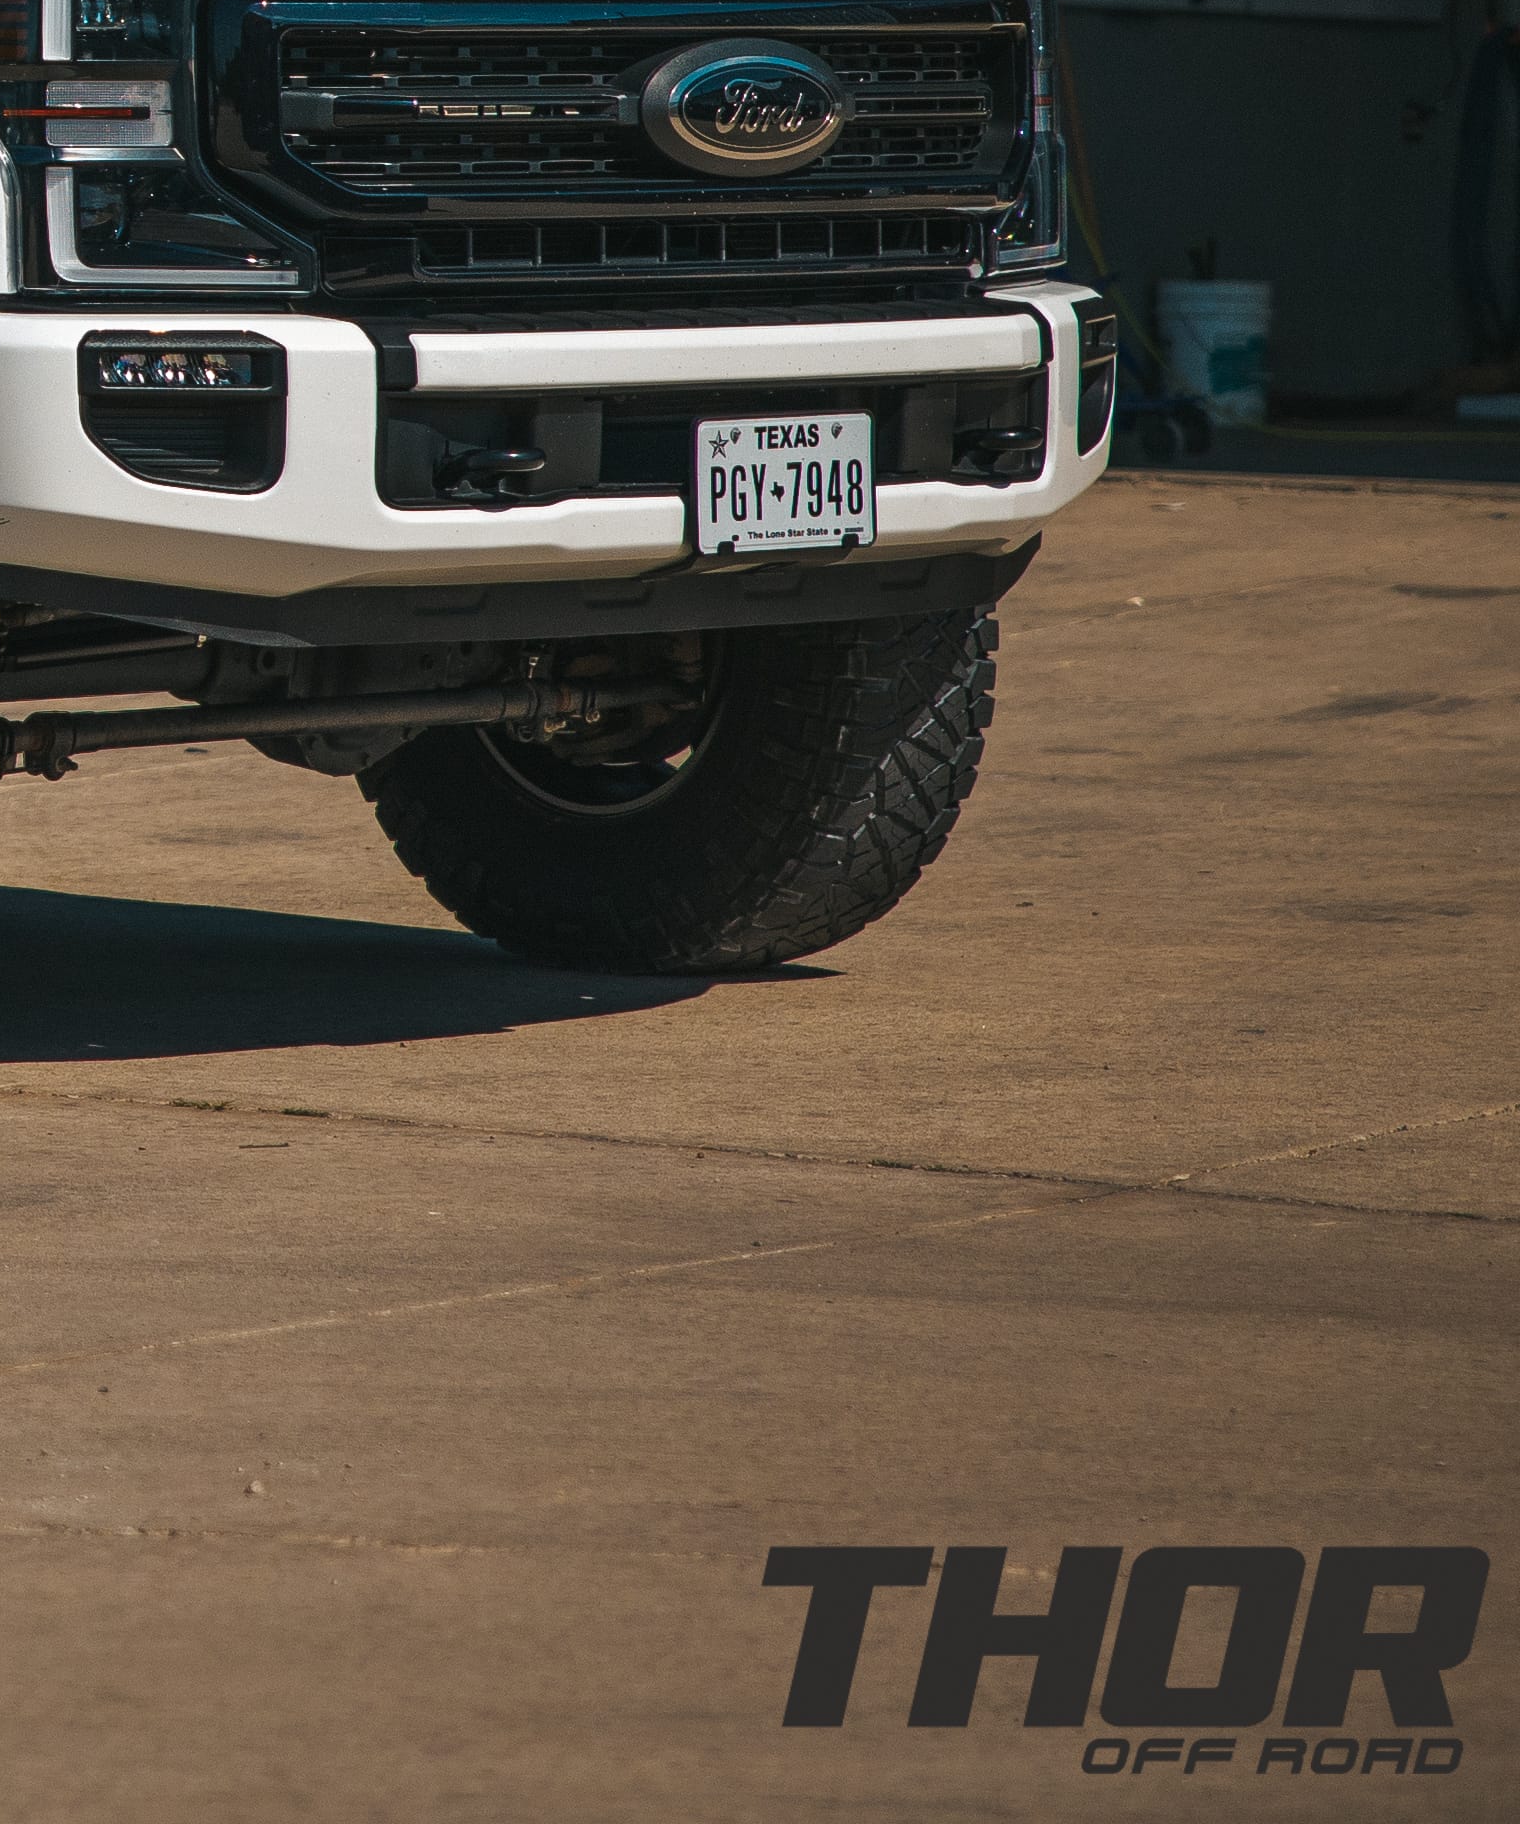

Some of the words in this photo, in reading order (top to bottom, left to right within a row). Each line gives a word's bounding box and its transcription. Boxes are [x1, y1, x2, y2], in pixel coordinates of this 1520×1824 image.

[714, 77, 805, 135] Ford
[753, 423, 820, 451] TEXAS
[710, 463, 767, 524] PGY
[786, 458, 864, 520] 7948
[747, 531, 764, 540] The
[765, 529, 786, 539] Lone
[787, 528, 805, 538] Star
[806, 527, 829, 537] State
